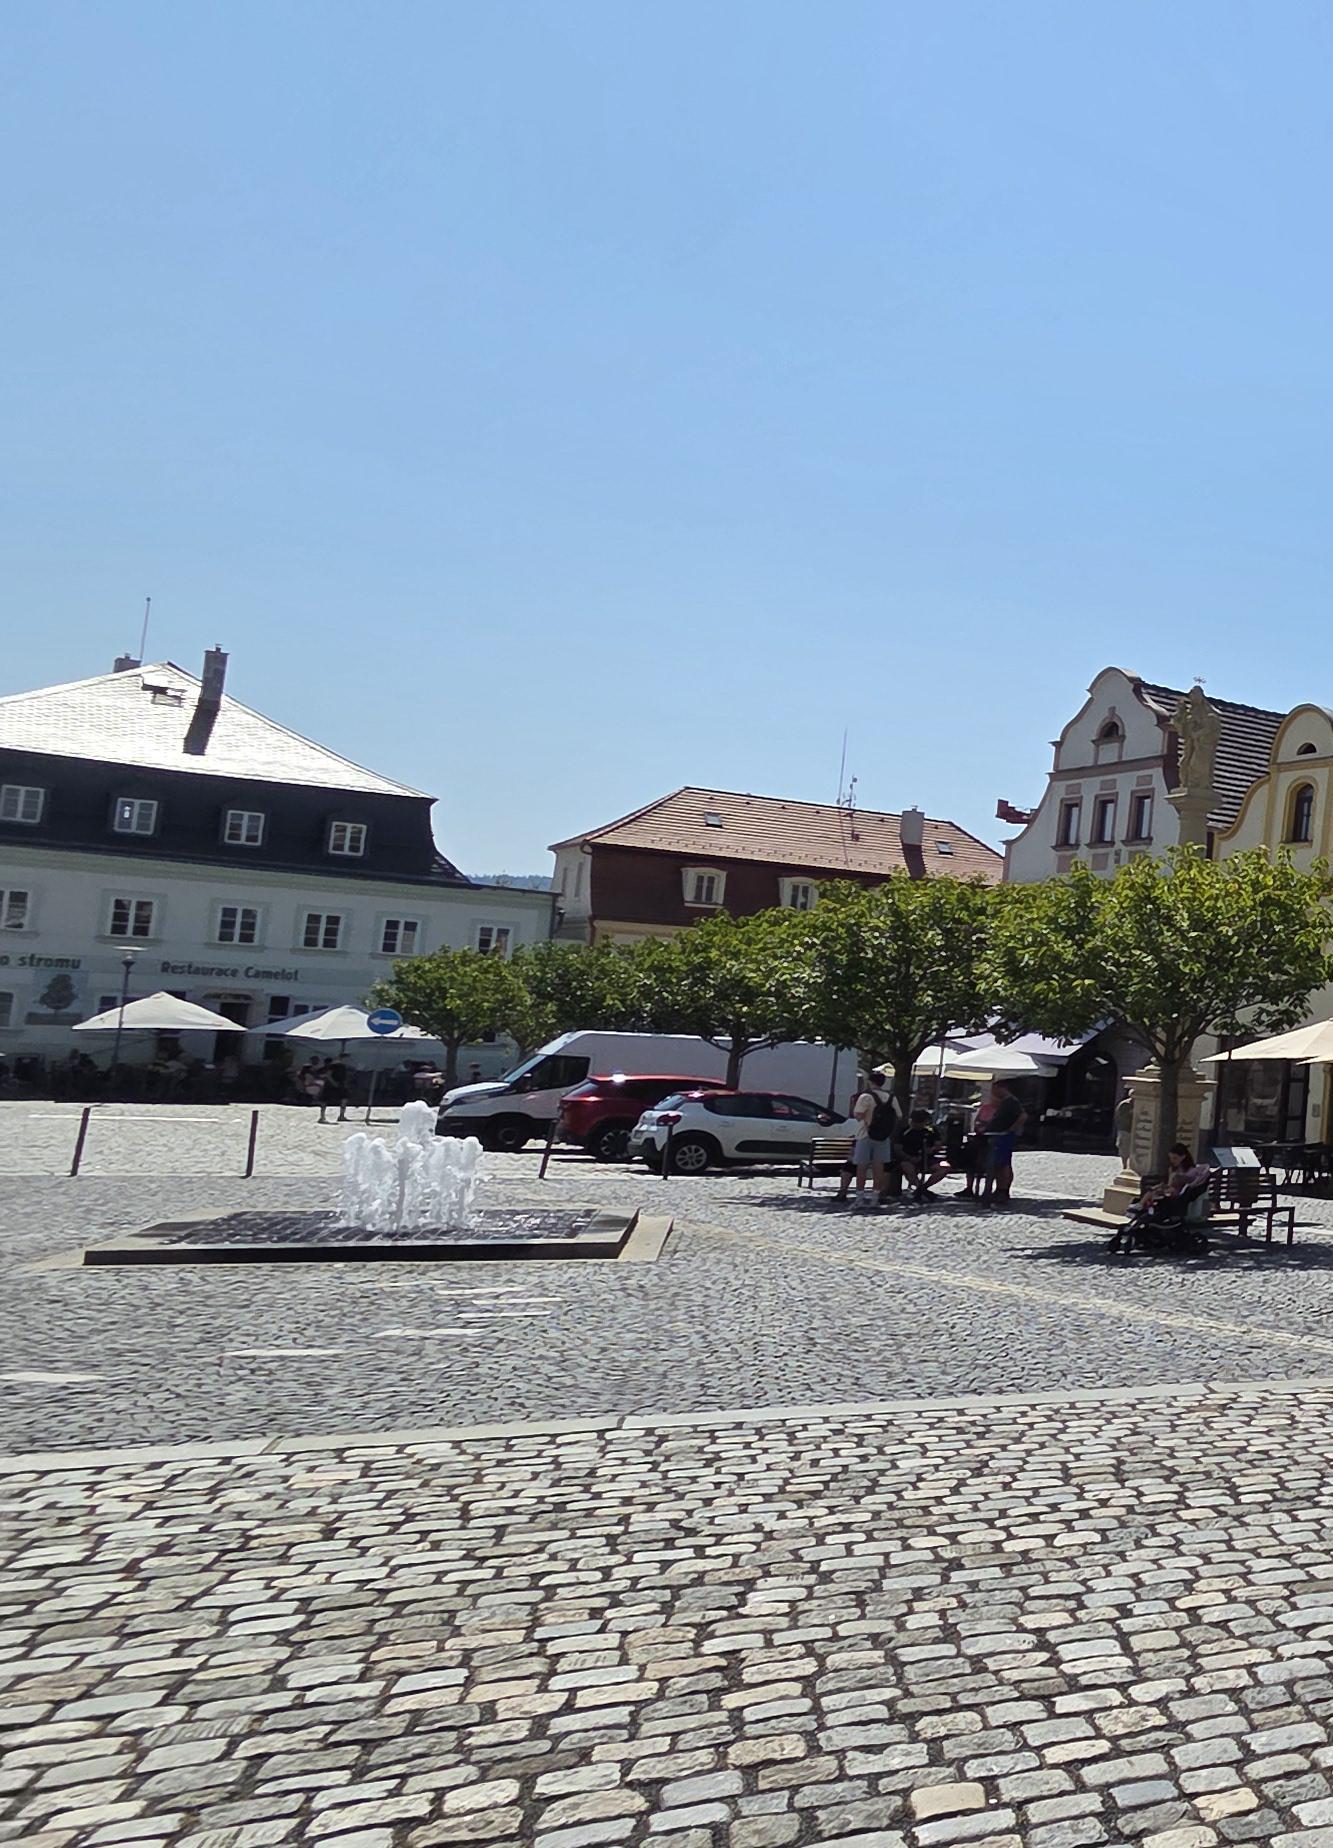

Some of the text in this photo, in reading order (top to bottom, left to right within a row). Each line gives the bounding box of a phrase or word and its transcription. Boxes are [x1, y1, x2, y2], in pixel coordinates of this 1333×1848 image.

[18, 953, 82, 969] stromu
[161, 961, 299, 981] Restaurace Camelot
